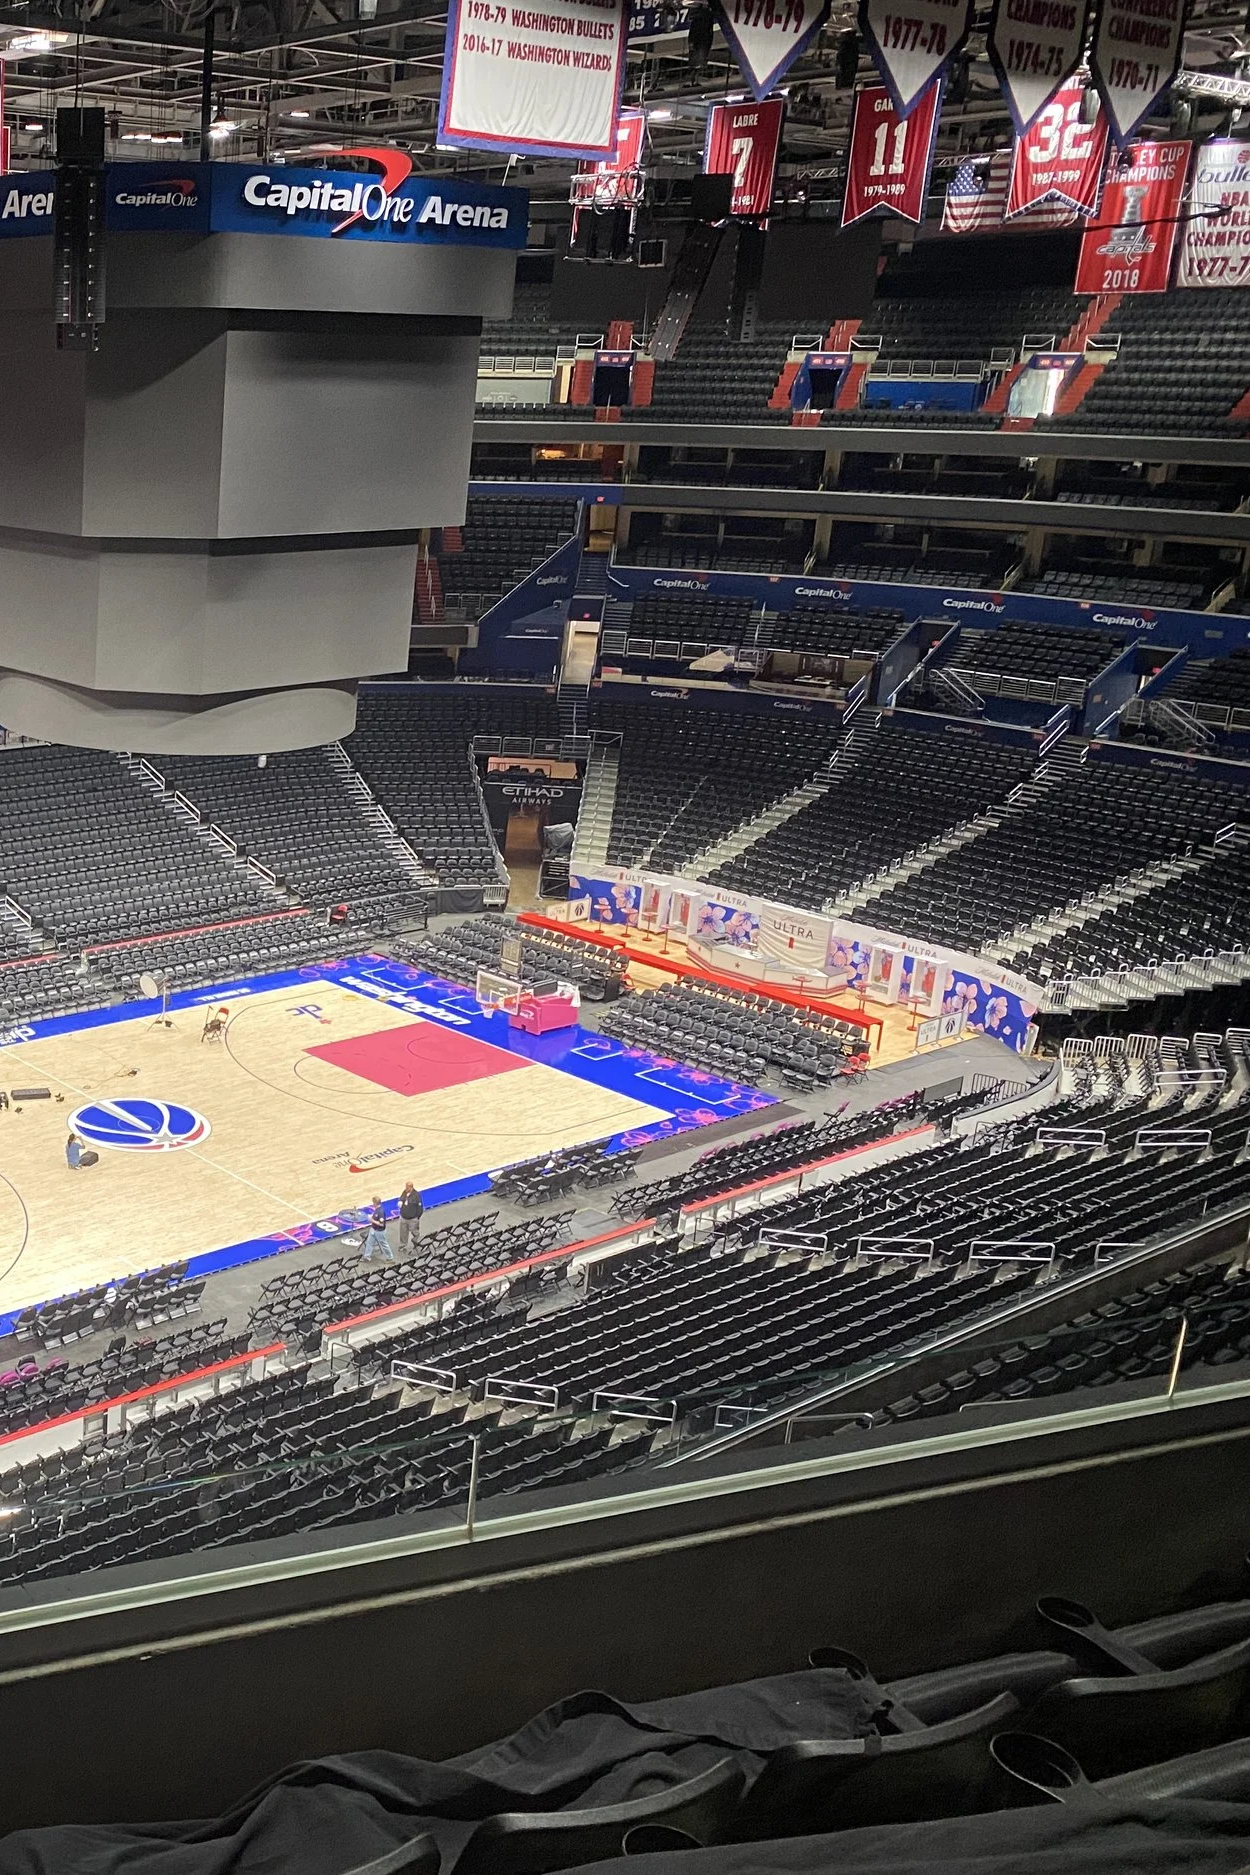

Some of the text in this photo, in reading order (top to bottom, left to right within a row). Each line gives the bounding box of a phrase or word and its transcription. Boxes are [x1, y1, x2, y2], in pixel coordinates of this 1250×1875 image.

[467, 1, 615, 41] 1978-79 WASHINGTON BULLETS
[883, 14, 947, 56] 1977-78
[1108, 15, 1172, 49] CHAMPIONS
[462, 34, 612, 73] 2016-17 WASHINGTON WIZARDS
[1007, 39, 1065, 76] 1974-75
[1108, 58, 1159, 92] 1970-71
[732, 113, 759, 128] LABRE
[1029, 102, 1097, 163] 32
[870, 120, 908, 176] 11
[1159, 146, 1185, 164] CUP
[732, 137, 754, 187] 7
[1031, 170, 1081, 186] 1987-1999
[1105, 163, 1176, 184] CHAMPIONS
[863, 183, 906, 197] 1979-1989
[1220, 192, 1250, 208] NBA
[420, 195, 509, 229] Arena
[1102, 269, 1140, 290] 2018
[502, 786, 564, 798] ETIHAD
[511, 797, 552, 805] AIRWAYS
[723, 894, 747, 908] ULTRA
[773, 920, 814, 940] ULTRA
[907, 944, 937, 958] ULTRA
[1006, 977, 1028, 995] ULTRA
[339, 976, 471, 1025] washington
[312, 1152, 350, 1165] Arena
